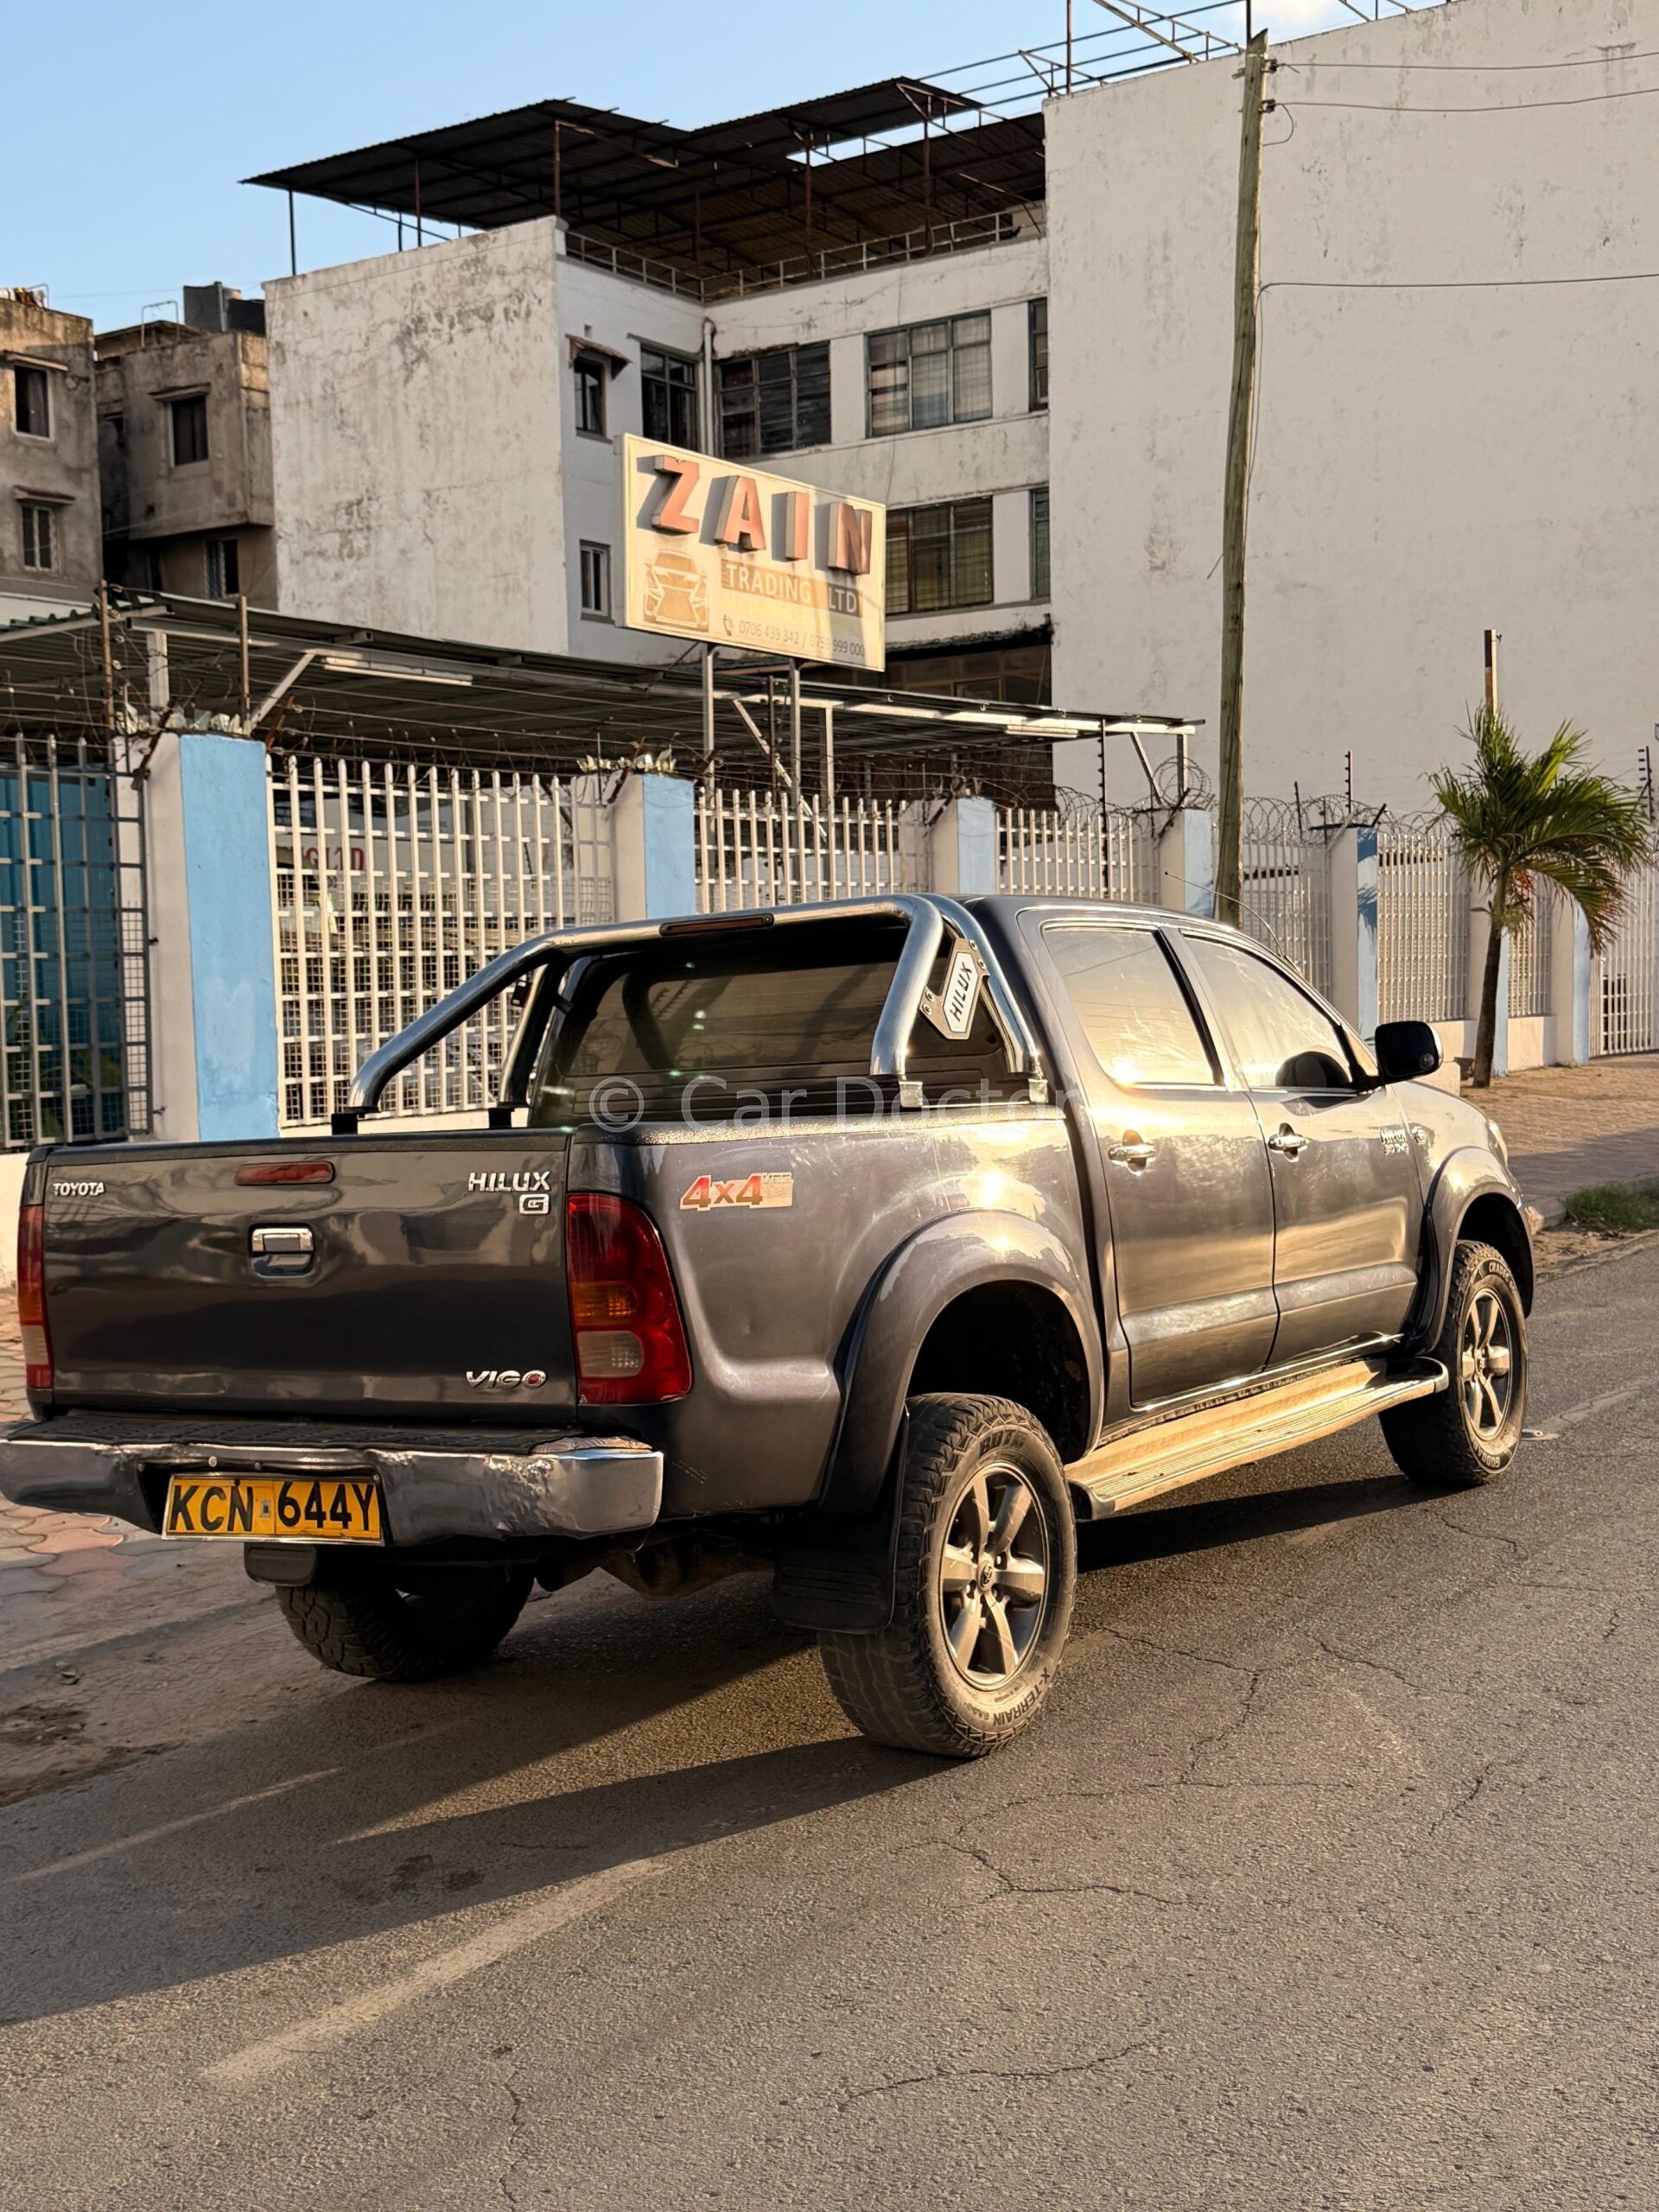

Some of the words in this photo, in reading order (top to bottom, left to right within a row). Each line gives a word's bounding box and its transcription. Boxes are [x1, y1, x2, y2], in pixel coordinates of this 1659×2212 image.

[652, 454, 872, 575] ZAIN
[725, 563, 812, 603] TRADING
[828, 586, 857, 613] LTD
[738, 620, 763, 639] 0706
[764, 625, 781, 642] 439
[782, 628, 801, 645] 342
[849, 642, 866, 658] 000
[950, 962, 972, 1022] HILUX
[53, 1182, 105, 1197] TOYOTA
[468, 1171, 550, 1192] HILUX
[682, 1174, 764, 1208] 4x4
[466, 1370, 548, 1389] VIGO
[169, 1484, 253, 1532] KCN
[277, 1480, 375, 1531] 644Y
